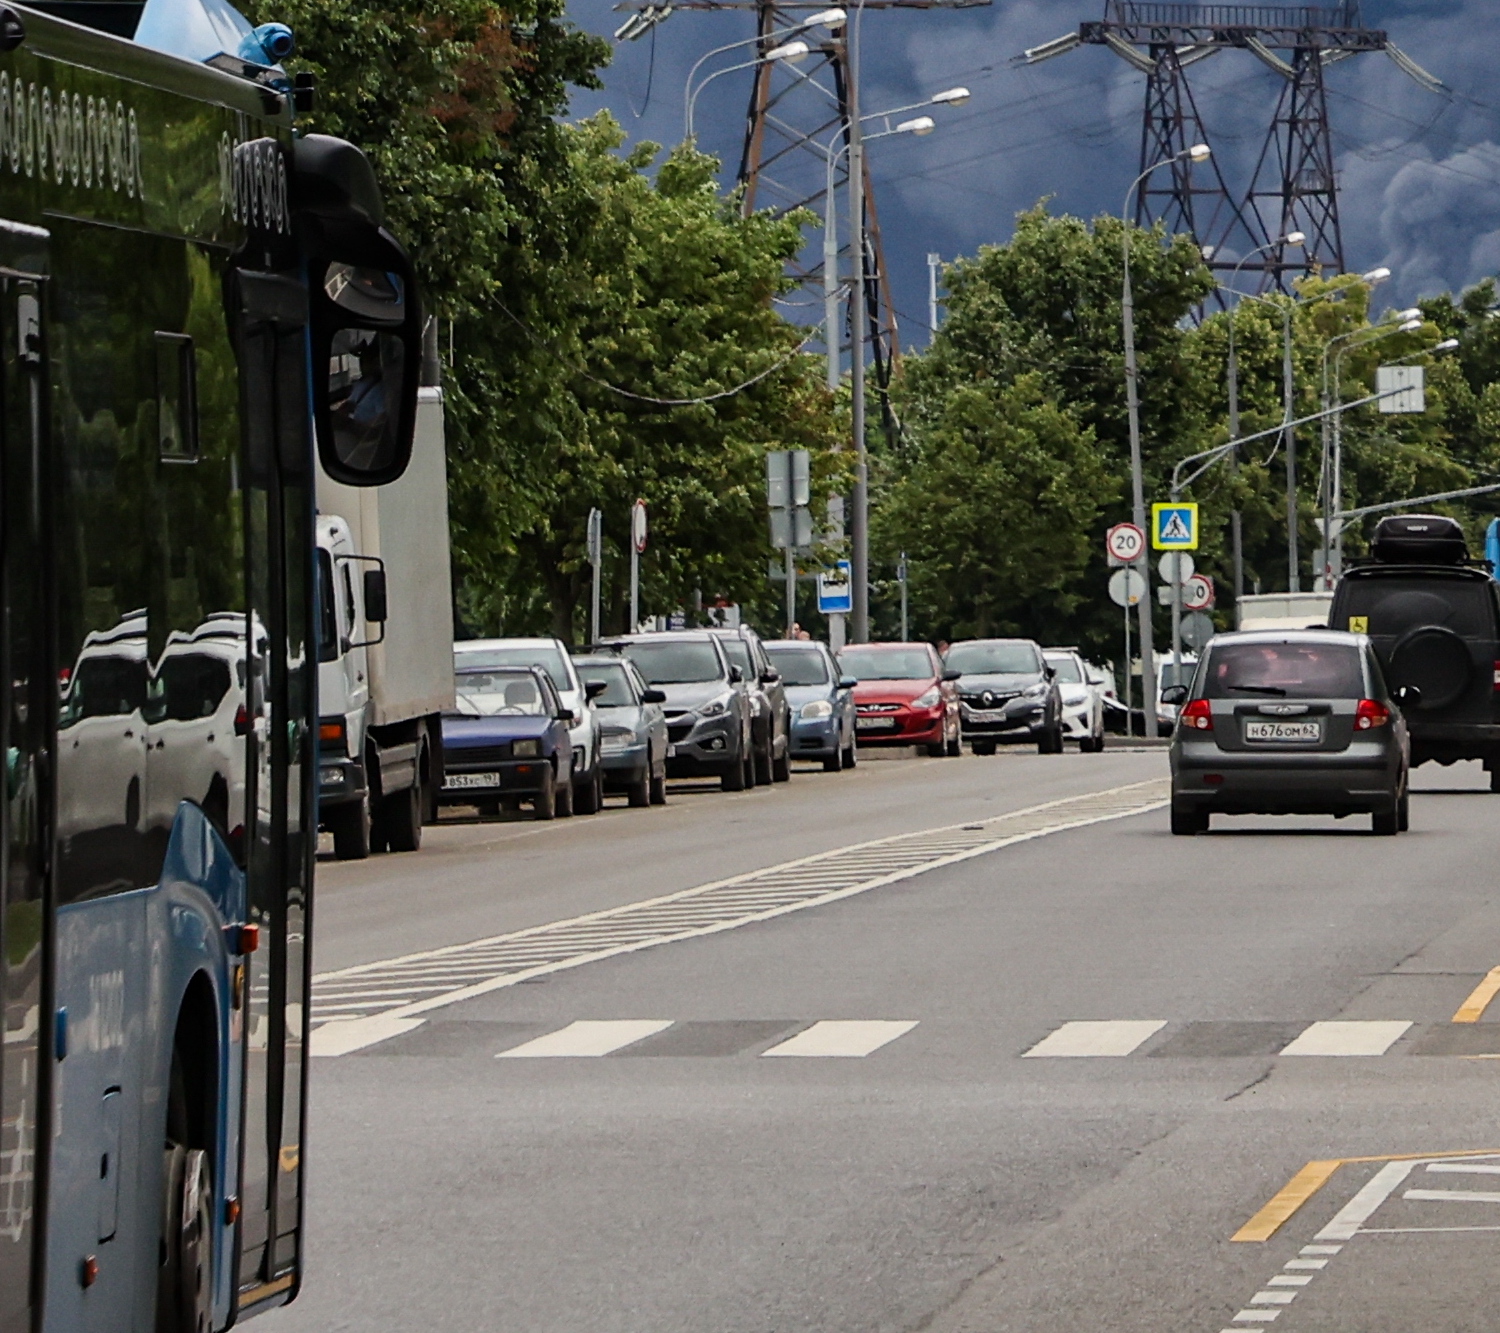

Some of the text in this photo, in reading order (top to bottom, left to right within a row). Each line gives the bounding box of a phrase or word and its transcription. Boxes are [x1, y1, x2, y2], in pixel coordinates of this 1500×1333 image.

[1116, 536, 1136, 550] 20
[1251, 724, 1315, 737] Н676ОМ 62
